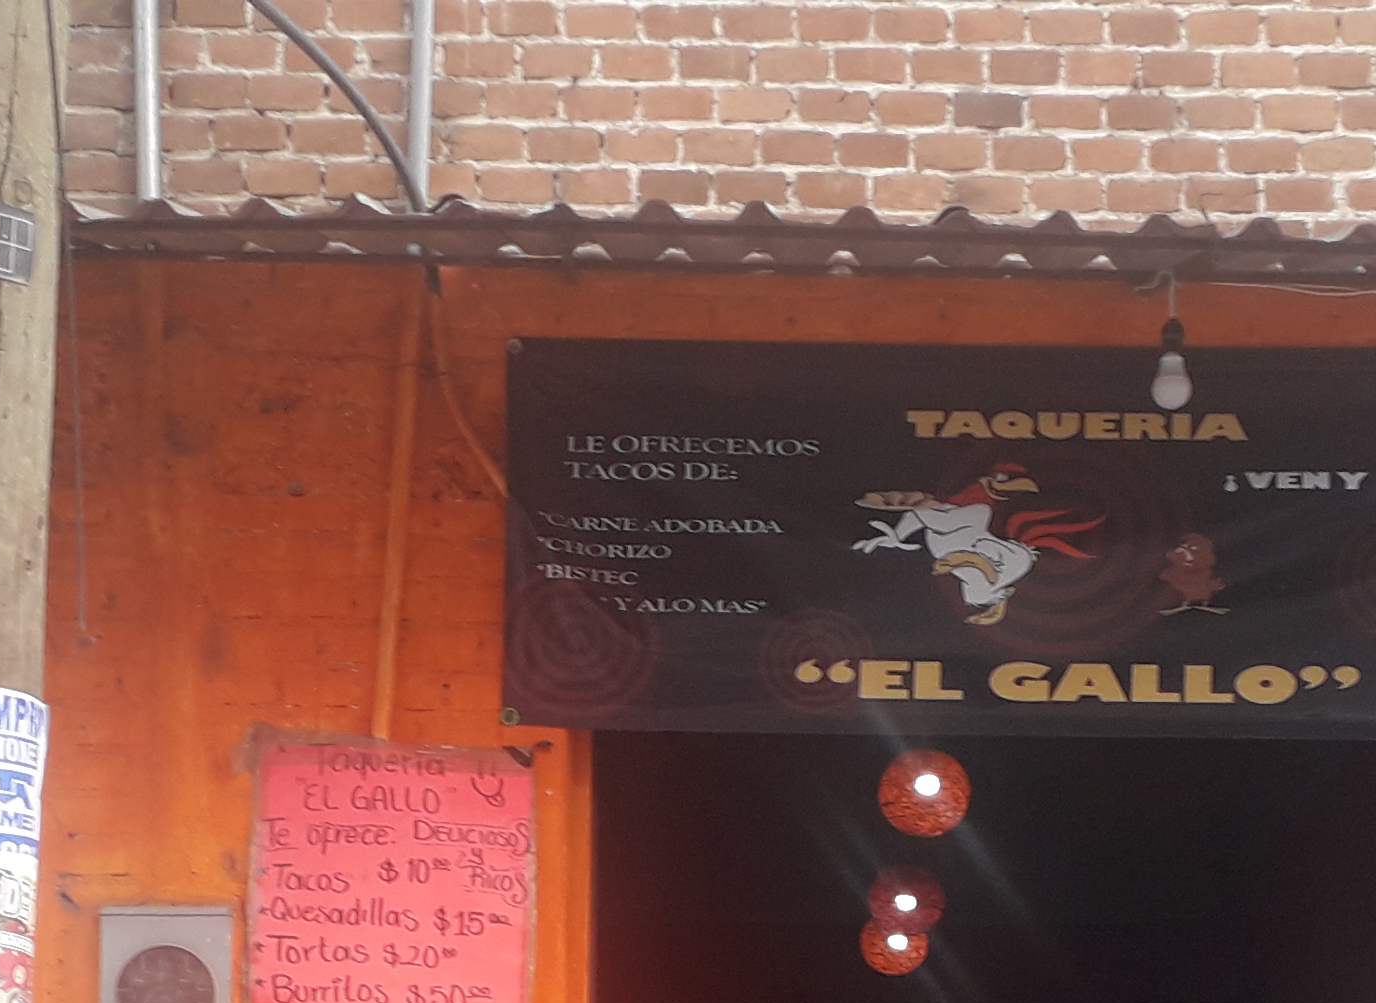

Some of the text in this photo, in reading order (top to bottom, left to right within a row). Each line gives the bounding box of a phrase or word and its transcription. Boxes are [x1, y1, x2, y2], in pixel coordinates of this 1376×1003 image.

[905, 409, 1249, 441] TAQUERIA
[566, 435, 821, 458] LE OFRECEMOS
[564, 461, 739, 482] TACOS DE:
[1334, 470, 1369, 492] Y
[543, 512, 785, 535] CARNE ADOBADA
[543, 538, 674, 560] CHORIZO
[543, 563, 641, 586] BISTEC
[262, 816, 300, 847] Te
[271, 862, 352, 894] Tacos
[264, 934, 371, 965] Tortas
